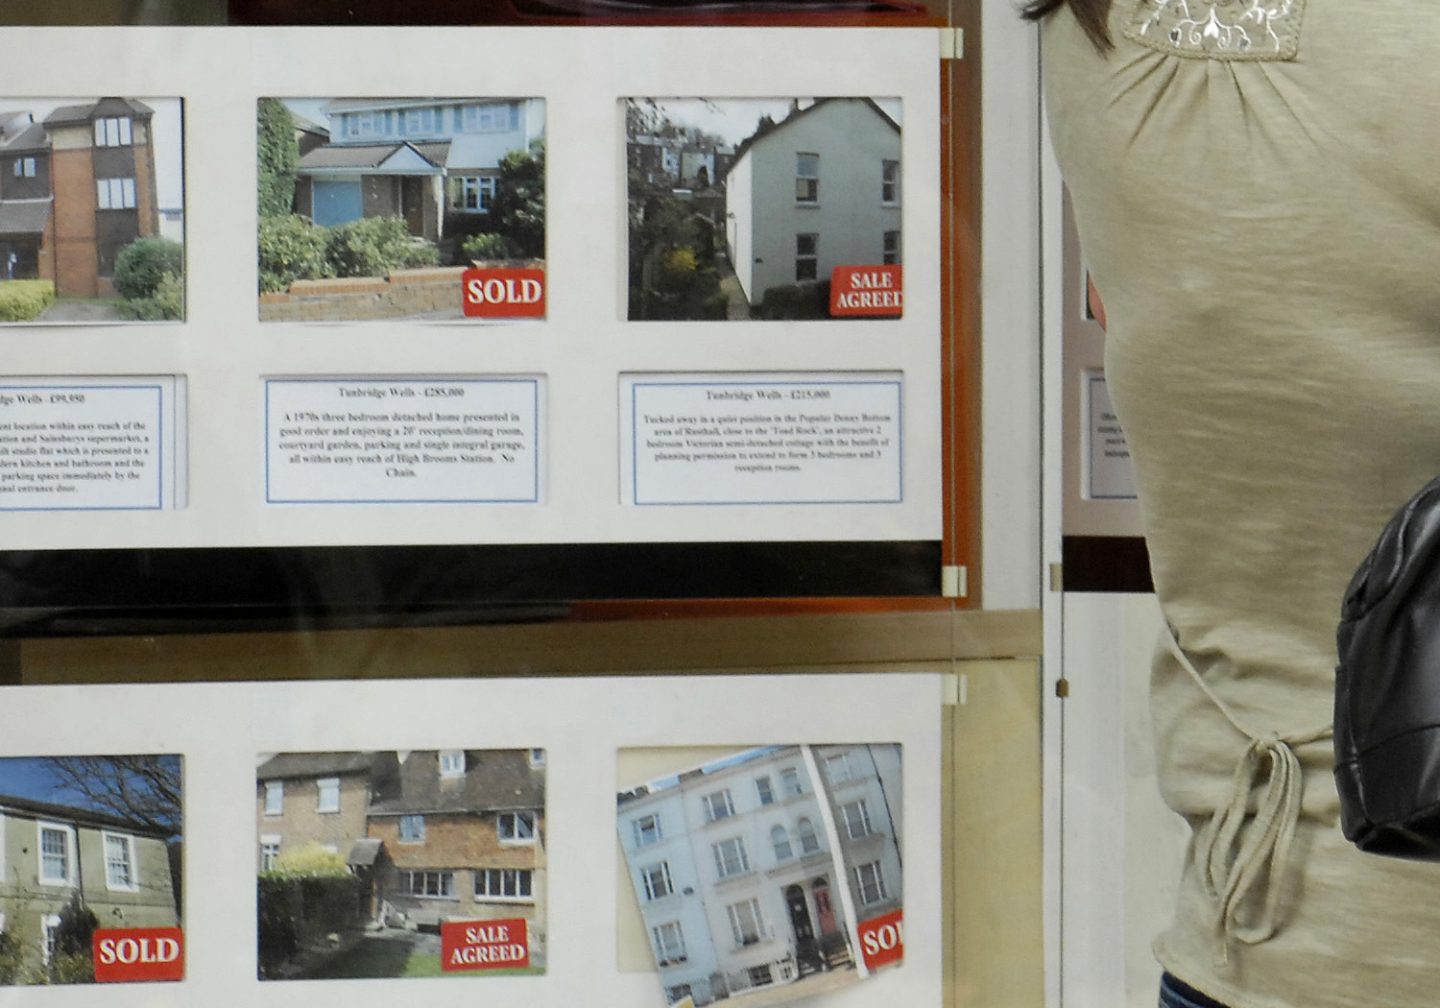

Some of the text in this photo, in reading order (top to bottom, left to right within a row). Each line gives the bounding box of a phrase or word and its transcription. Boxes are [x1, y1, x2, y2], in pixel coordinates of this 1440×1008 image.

[851, 273, 892, 288] SALE
[468, 280, 541, 303] SOLD
[17, 395, 42, 403] Wells
[339, 388, 386, 399] Tunbridge
[390, 388, 415, 396] Wells
[707, 391, 753, 401] Tunbridge
[757, 391, 781, 399] Wells
[322, 413, 345, 421] three
[348, 413, 389, 421] bedroom
[392, 413, 433, 421] detached
[436, 413, 460, 421] home
[463, 414, 508, 423] presented
[466, 926, 508, 944] SALE
[100, 938, 179, 963] SOLD
[451, 941, 524, 963] AGREED
